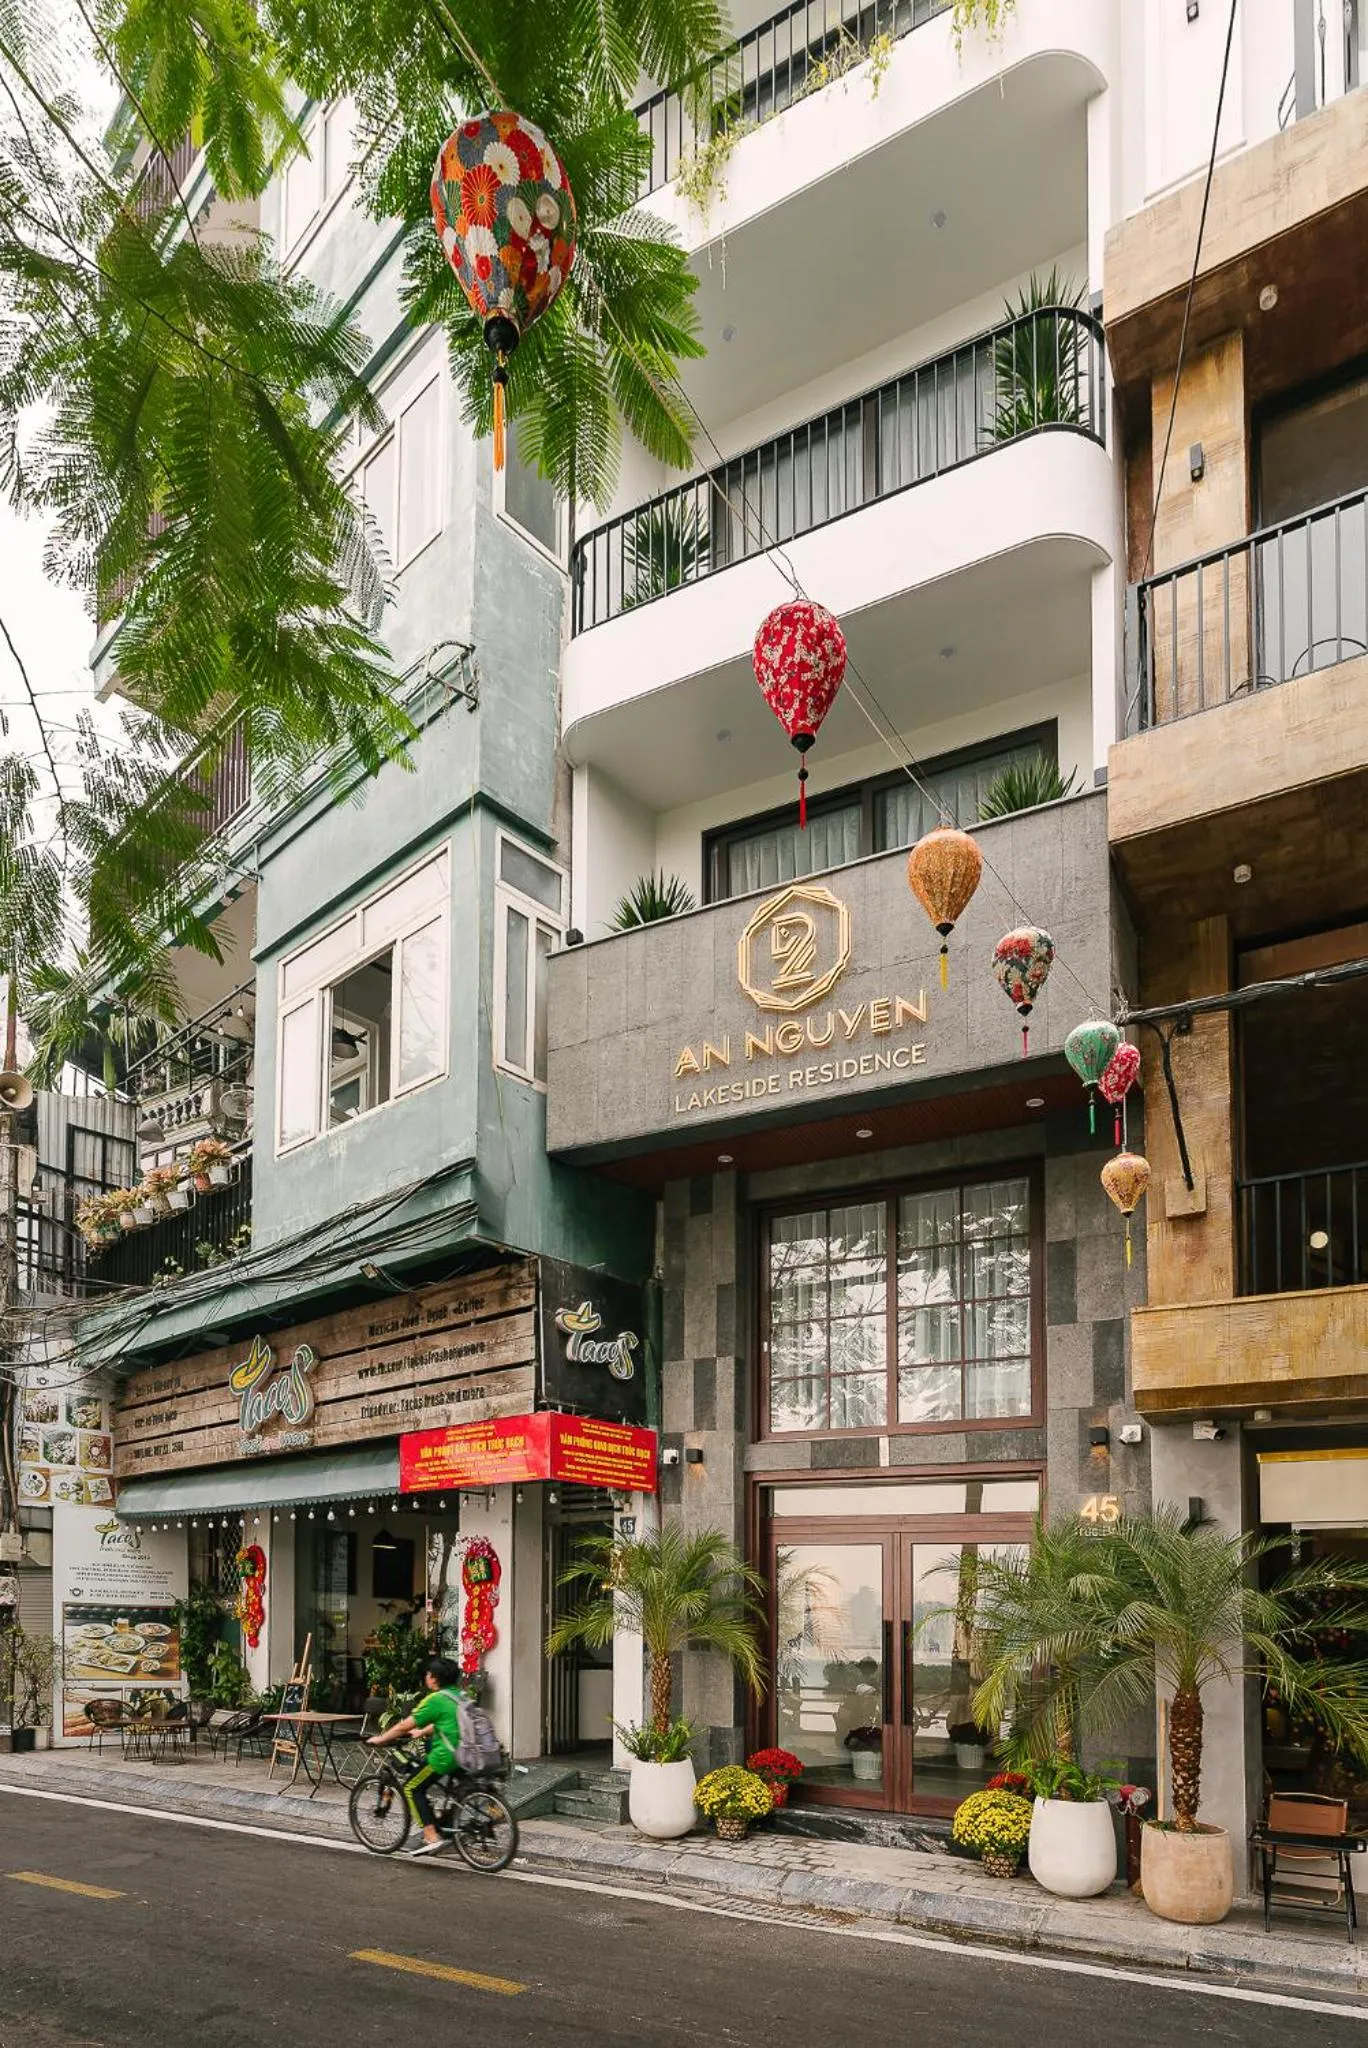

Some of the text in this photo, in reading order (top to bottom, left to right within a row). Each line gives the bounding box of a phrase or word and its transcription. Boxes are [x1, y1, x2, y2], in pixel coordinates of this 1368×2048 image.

[674, 988, 927, 1077] AN NGUYEN
[675, 1043, 927, 1113] LAKESIDE RESIDENCE
[621, 1519, 634, 1533] 45
[1081, 1495, 1119, 1522] 45
